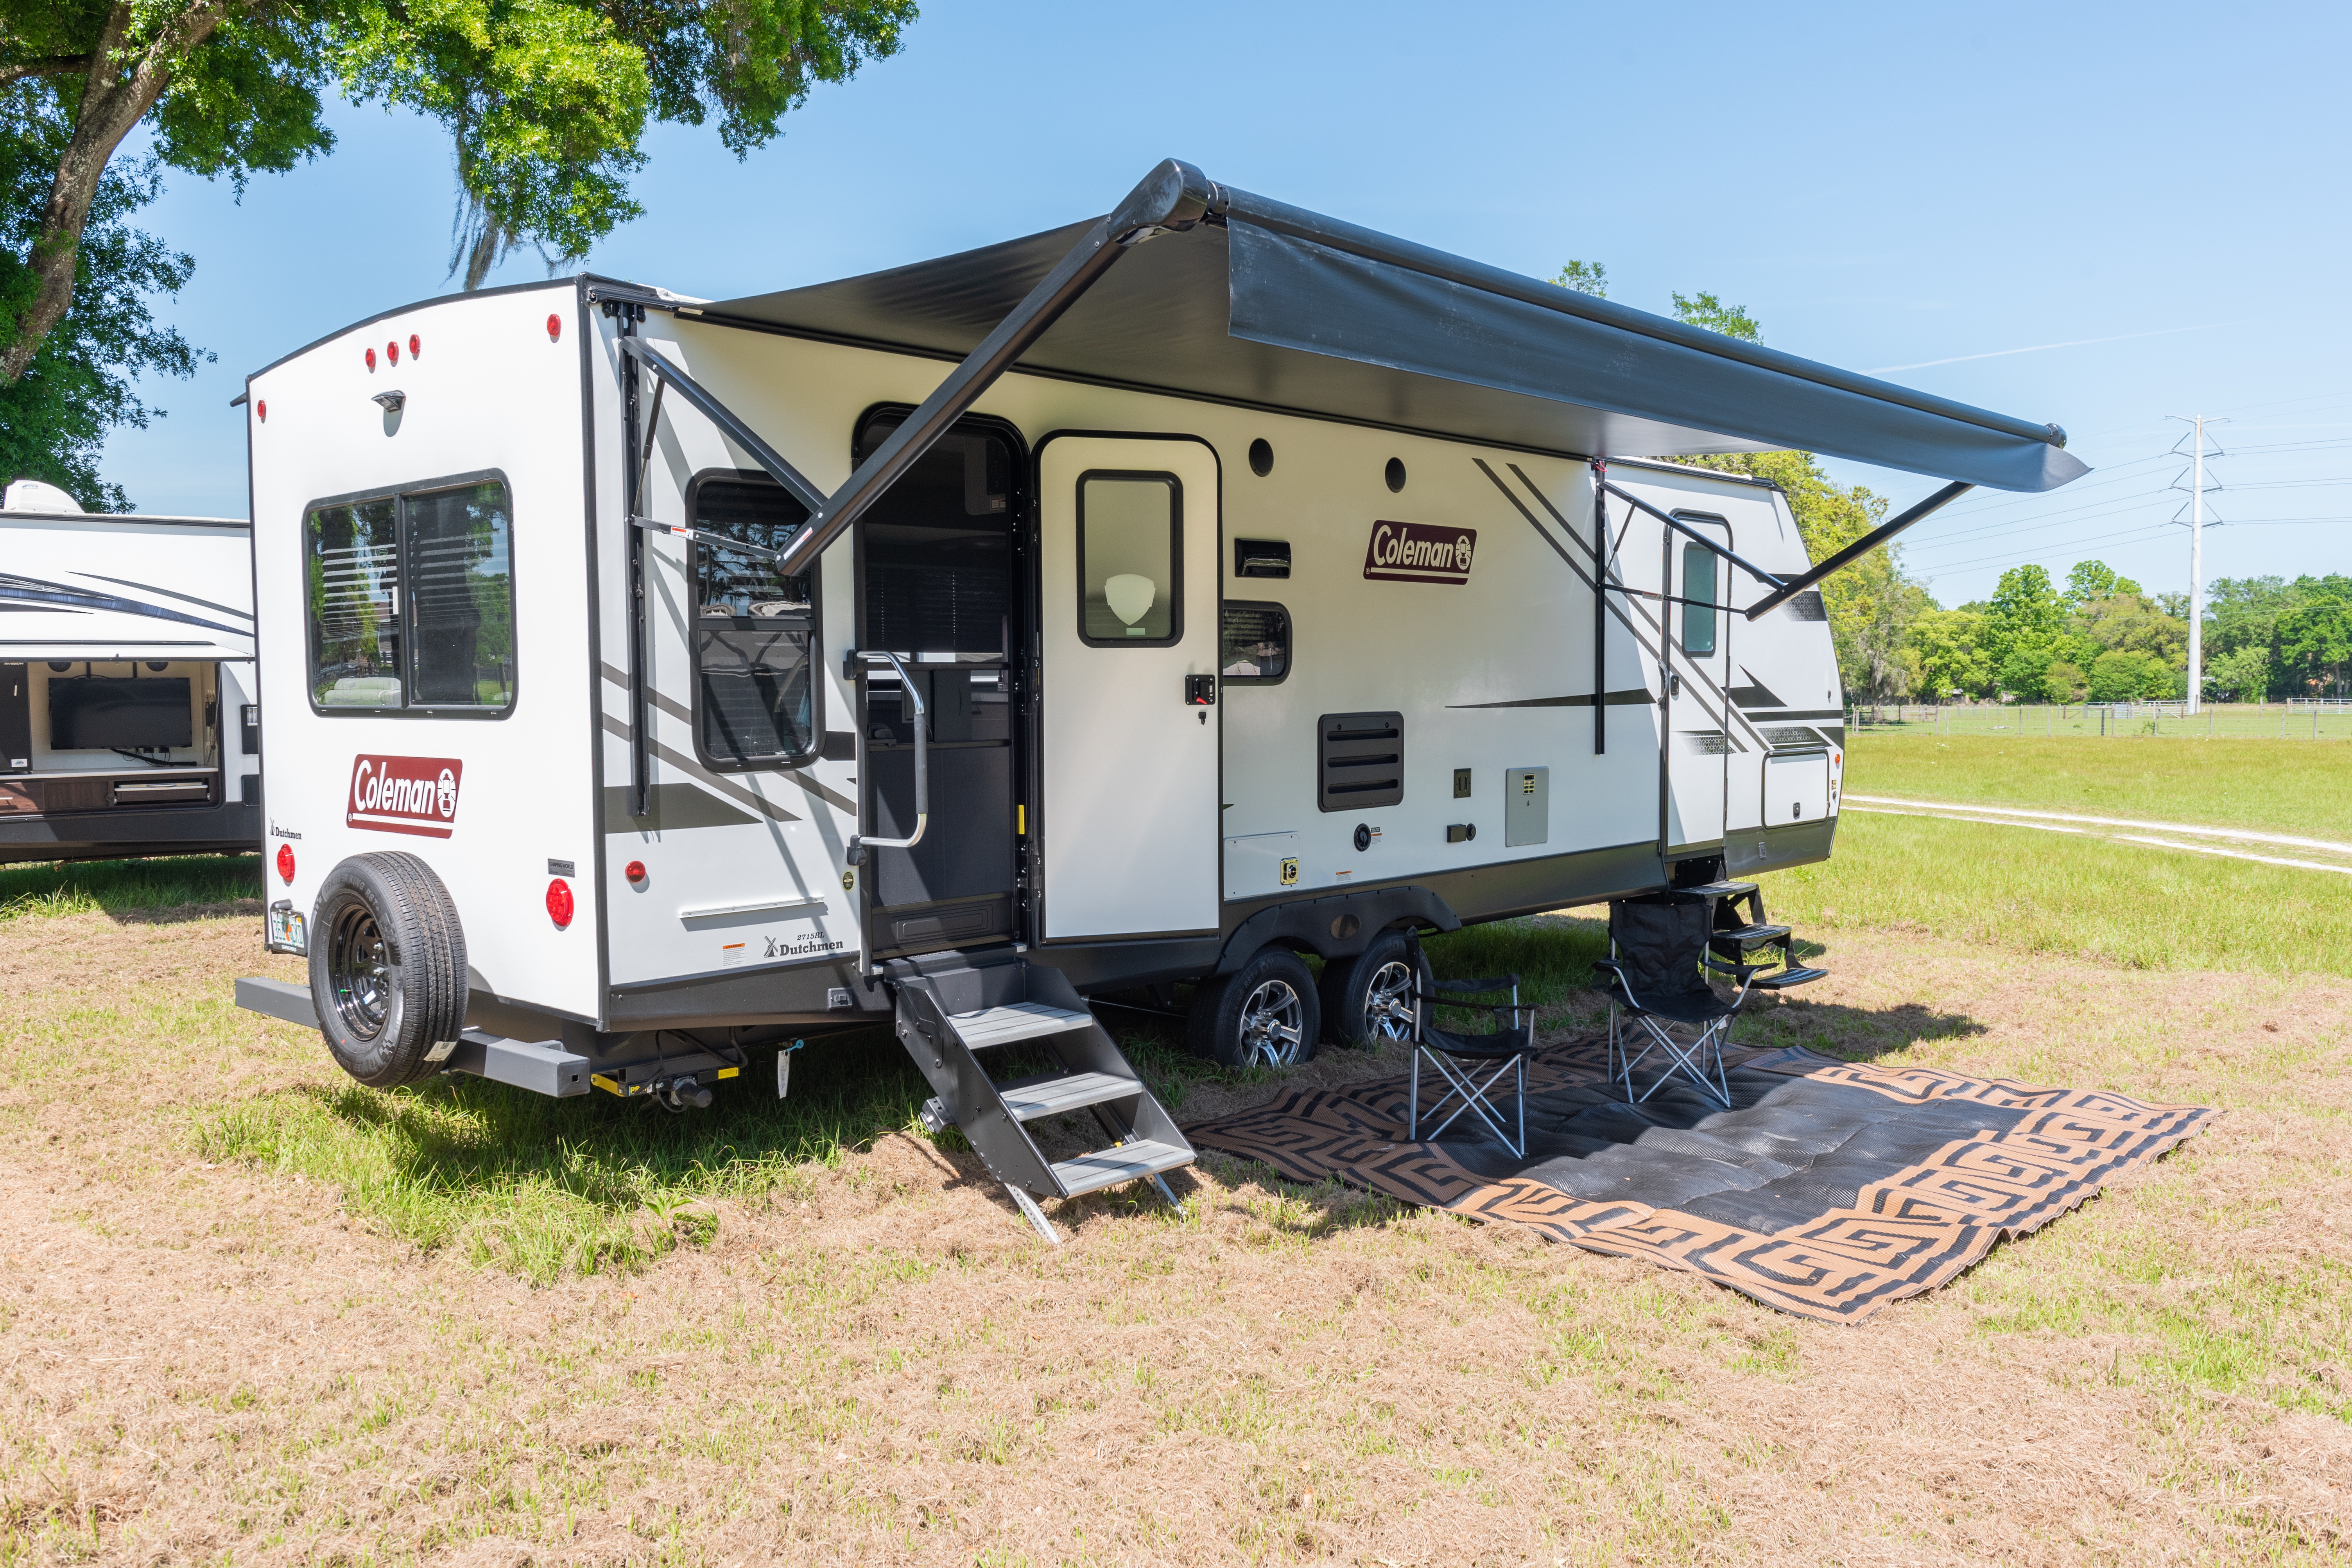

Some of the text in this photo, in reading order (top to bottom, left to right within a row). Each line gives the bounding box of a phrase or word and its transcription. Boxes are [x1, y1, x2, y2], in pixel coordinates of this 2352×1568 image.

[1373, 525, 1454, 568] Coleman
[354, 759, 436, 814] Coleman
[276, 826, 302, 840] Dutchmen
[349, 875, 365, 891] KING
[797, 932, 825, 941] 2715RL
[780, 941, 843, 956] Dutchmen
